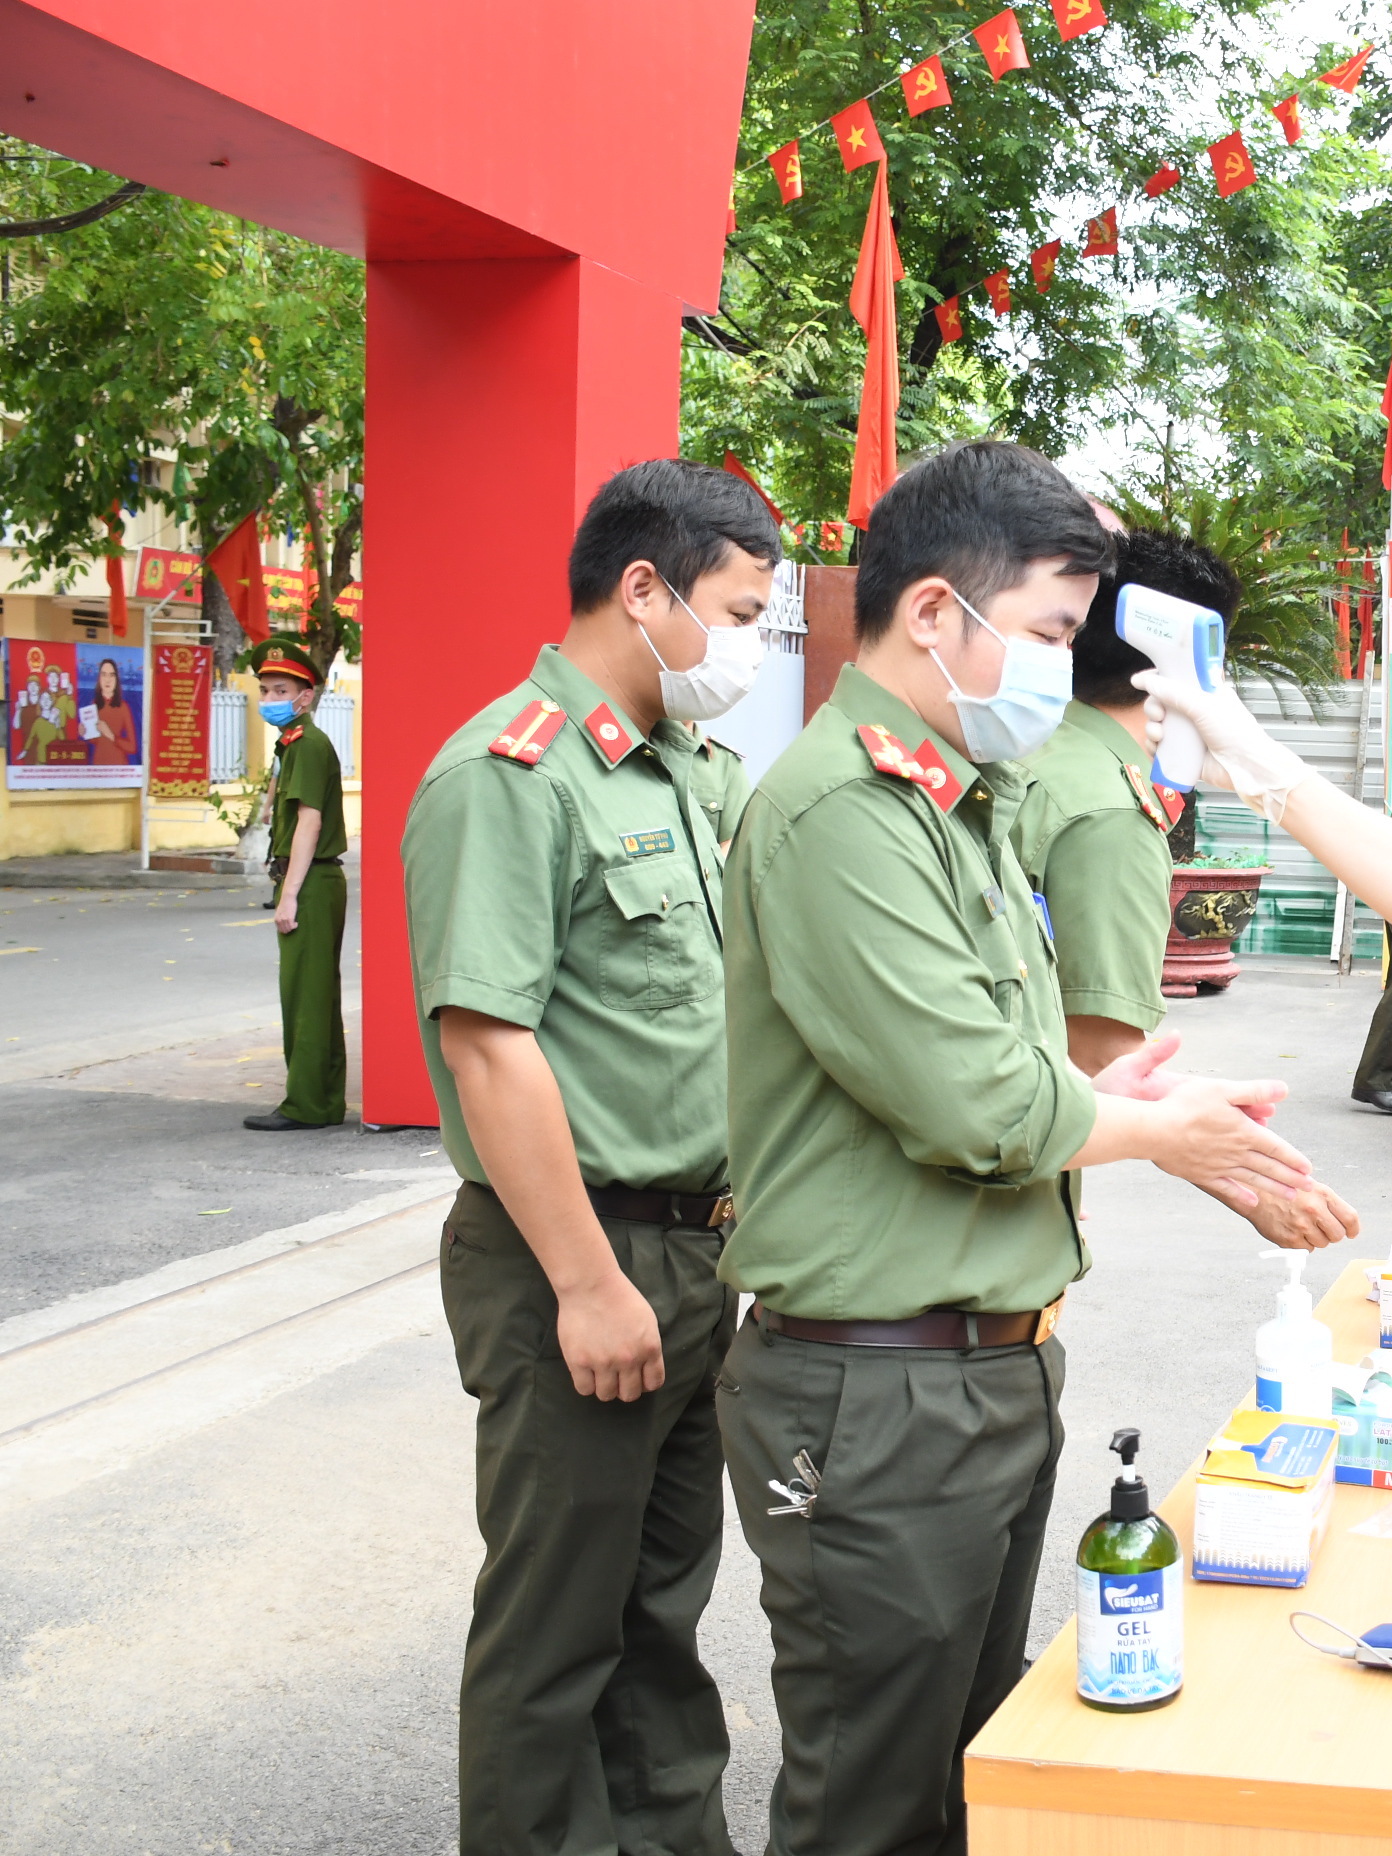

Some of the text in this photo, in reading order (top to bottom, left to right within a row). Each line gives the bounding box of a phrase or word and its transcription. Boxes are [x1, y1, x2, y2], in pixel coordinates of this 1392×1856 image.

[1376, 1437, 1389, 1446] 100
[1117, 1621, 1151, 1636] GEL
[1137, 1637, 1151, 1646] TAY
[1110, 1651, 1137, 1675] NANO
